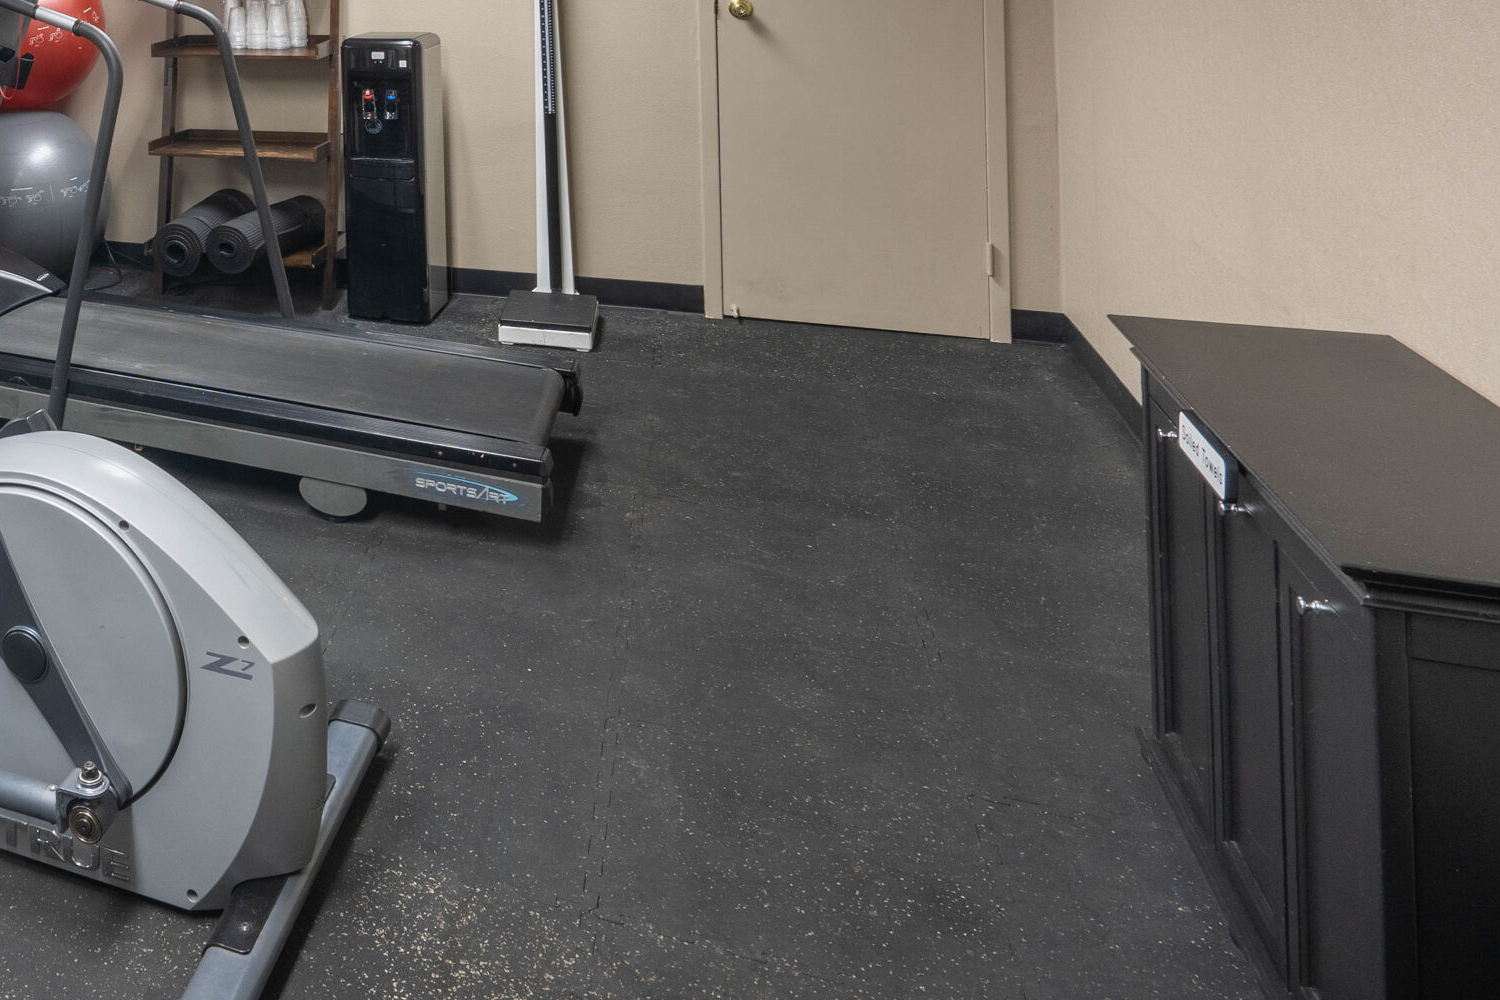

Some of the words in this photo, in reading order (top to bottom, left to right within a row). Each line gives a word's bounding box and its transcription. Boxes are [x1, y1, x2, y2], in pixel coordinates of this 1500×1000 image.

[1182, 424, 1200, 457] Soiled
[1201, 447, 1223, 485] Towels
[415, 477, 510, 505] SPORTSART
